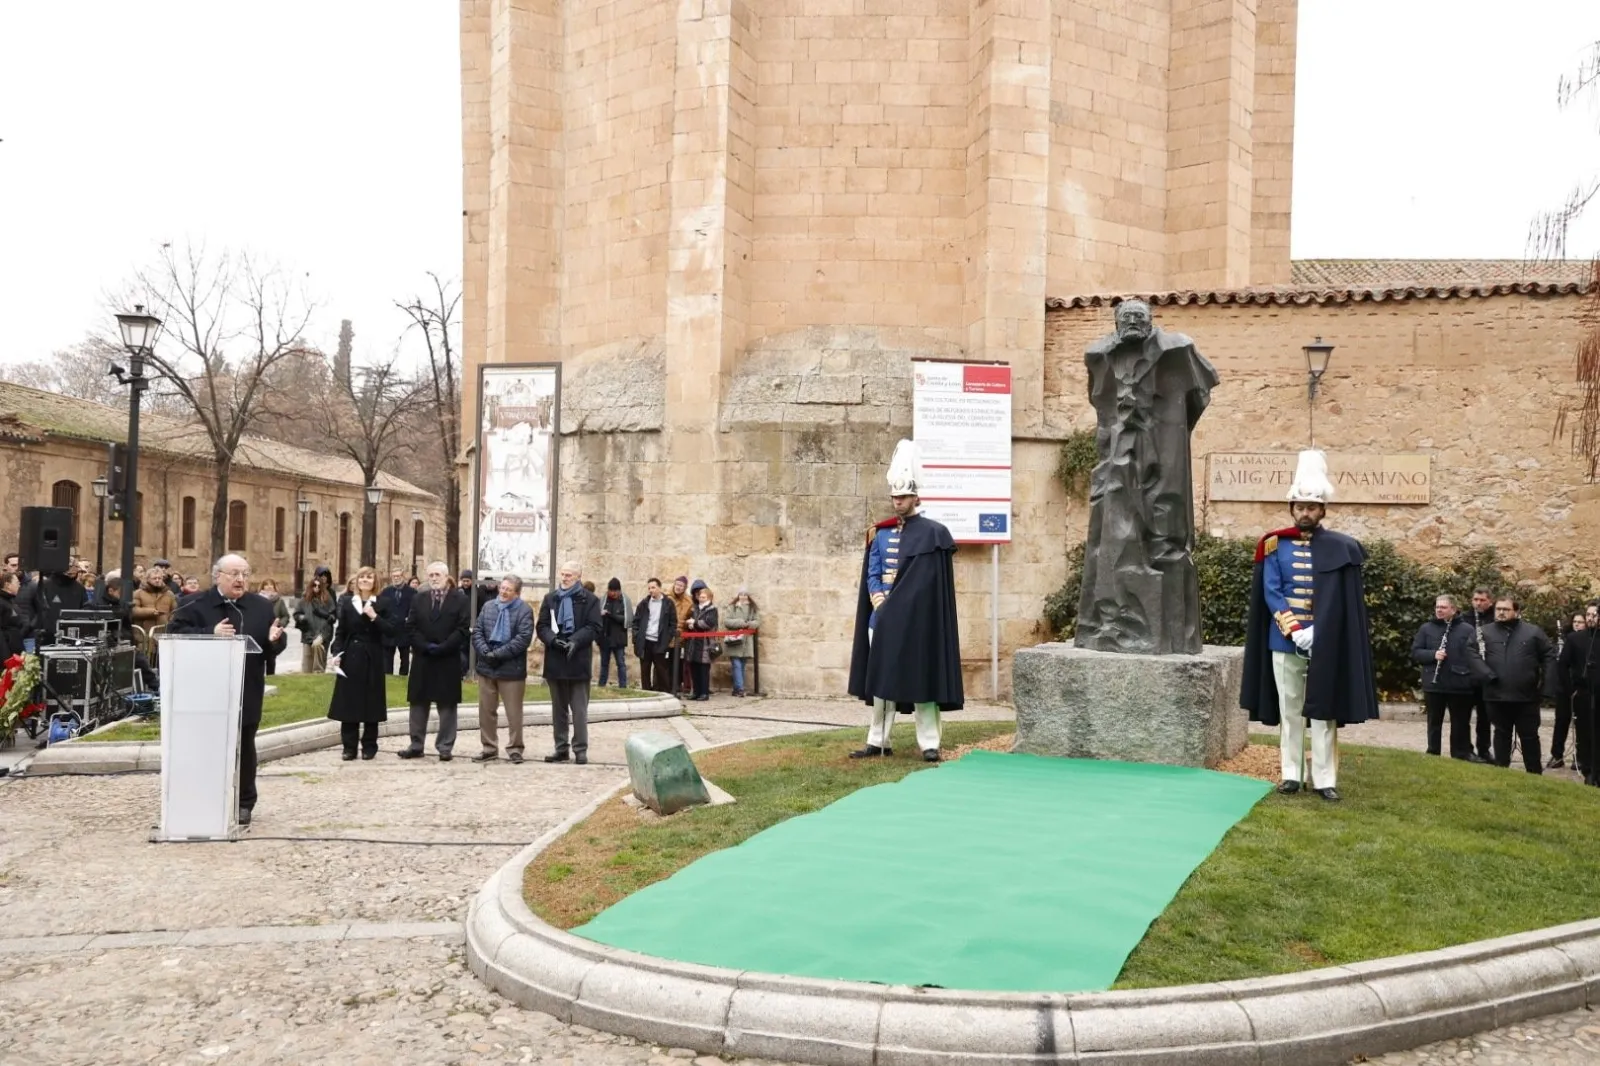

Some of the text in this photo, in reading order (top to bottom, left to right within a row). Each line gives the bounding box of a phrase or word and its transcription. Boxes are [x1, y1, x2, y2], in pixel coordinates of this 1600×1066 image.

[1214, 455, 1288, 465] SALAMANCA
[1213, 470, 1224, 484] A
[1334, 471, 1428, 486] VNAMVNO
